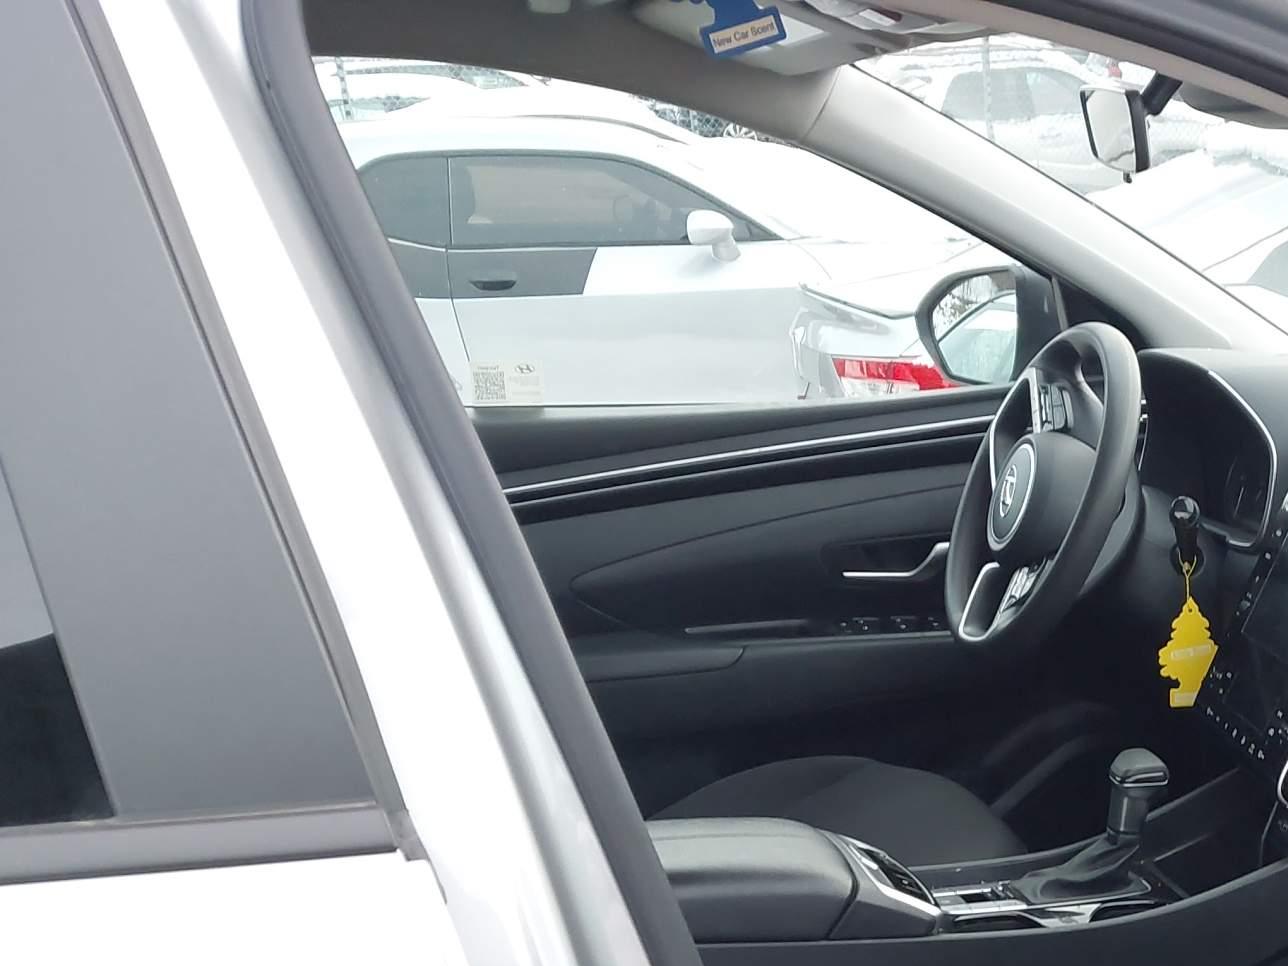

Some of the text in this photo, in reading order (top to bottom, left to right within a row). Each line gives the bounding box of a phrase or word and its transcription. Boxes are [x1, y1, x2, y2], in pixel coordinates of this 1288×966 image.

[713, 22, 776, 48] New Car Scent
